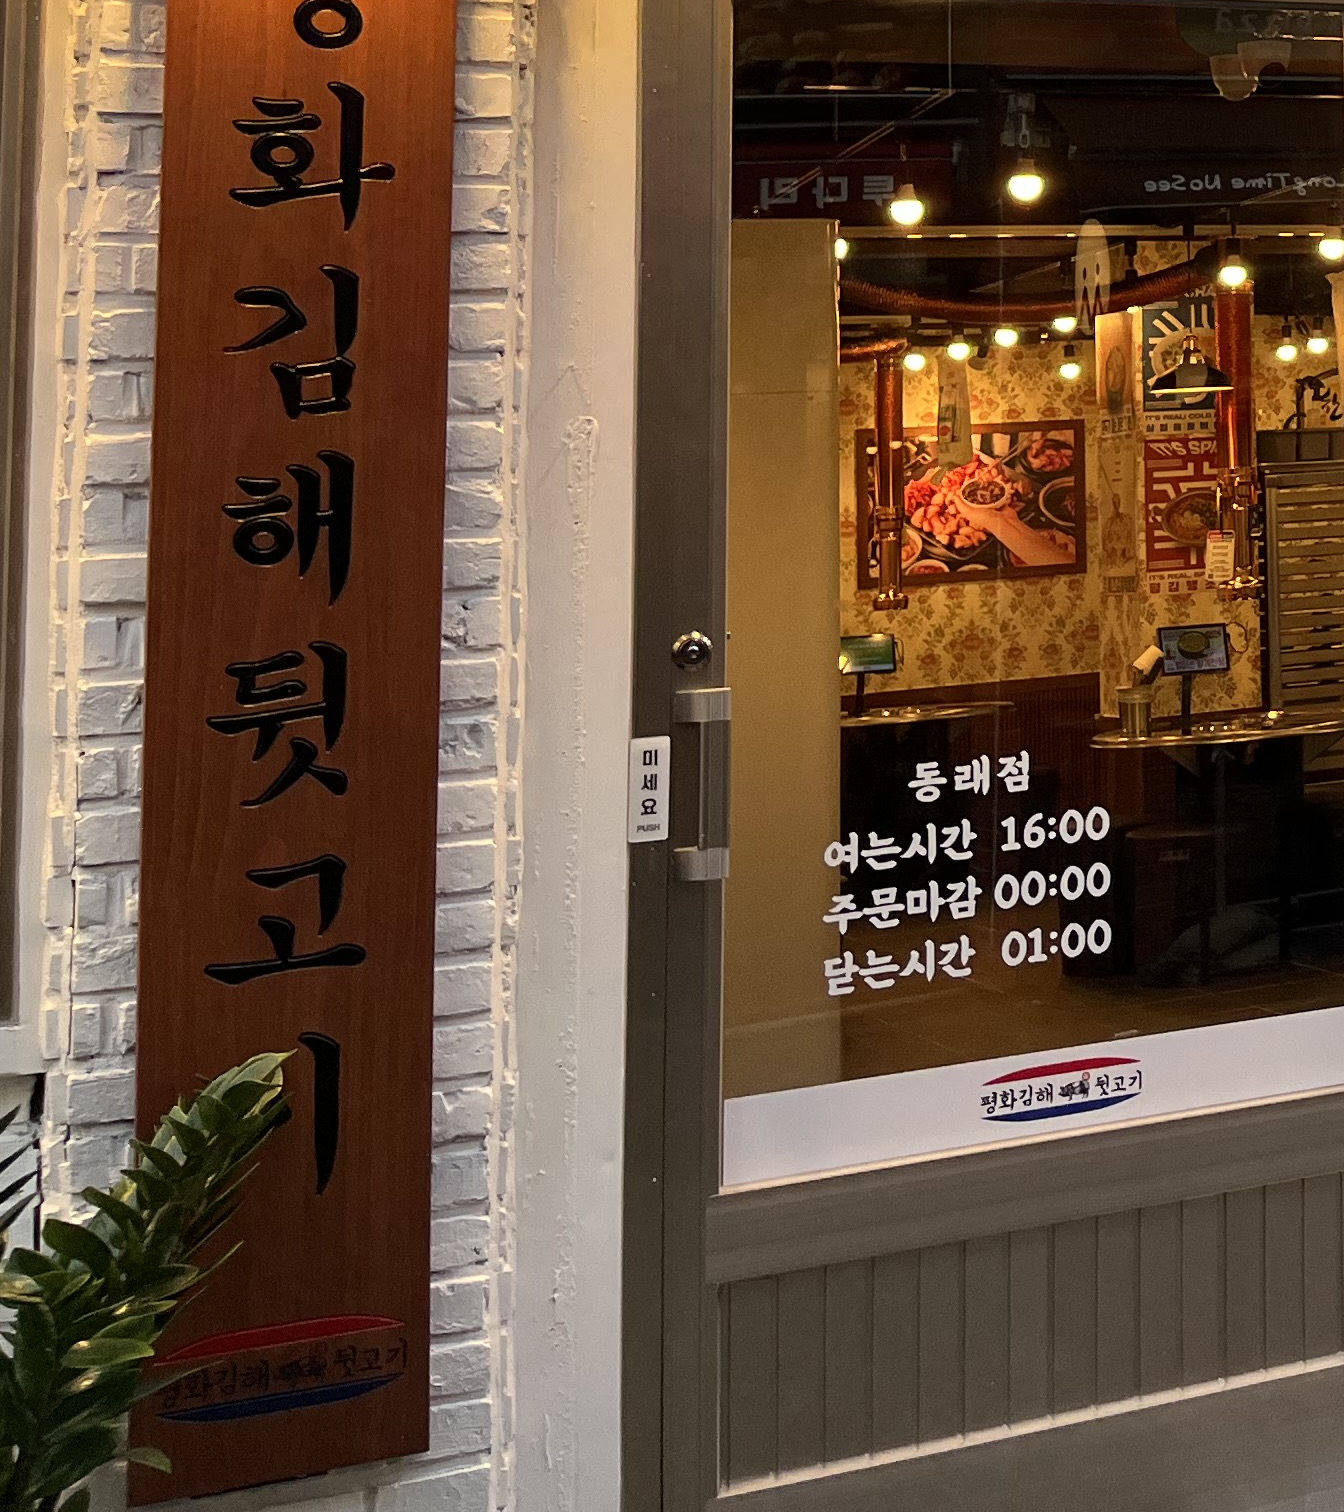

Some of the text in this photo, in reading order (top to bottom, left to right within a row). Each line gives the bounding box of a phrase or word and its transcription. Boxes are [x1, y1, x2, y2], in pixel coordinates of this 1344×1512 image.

[640, 749, 658, 816] 미세요
[907, 750, 1032, 804] 동래점
[637, 823, 660, 833] PUSH
[823, 806, 1111, 875] 여는시간 16:00
[823, 863, 1111, 934] 주문마감 00:00
[823, 919, 1112, 997] 닫는시간 01:00
[980, 1070, 1143, 1115] 평화김해 뒷고기
